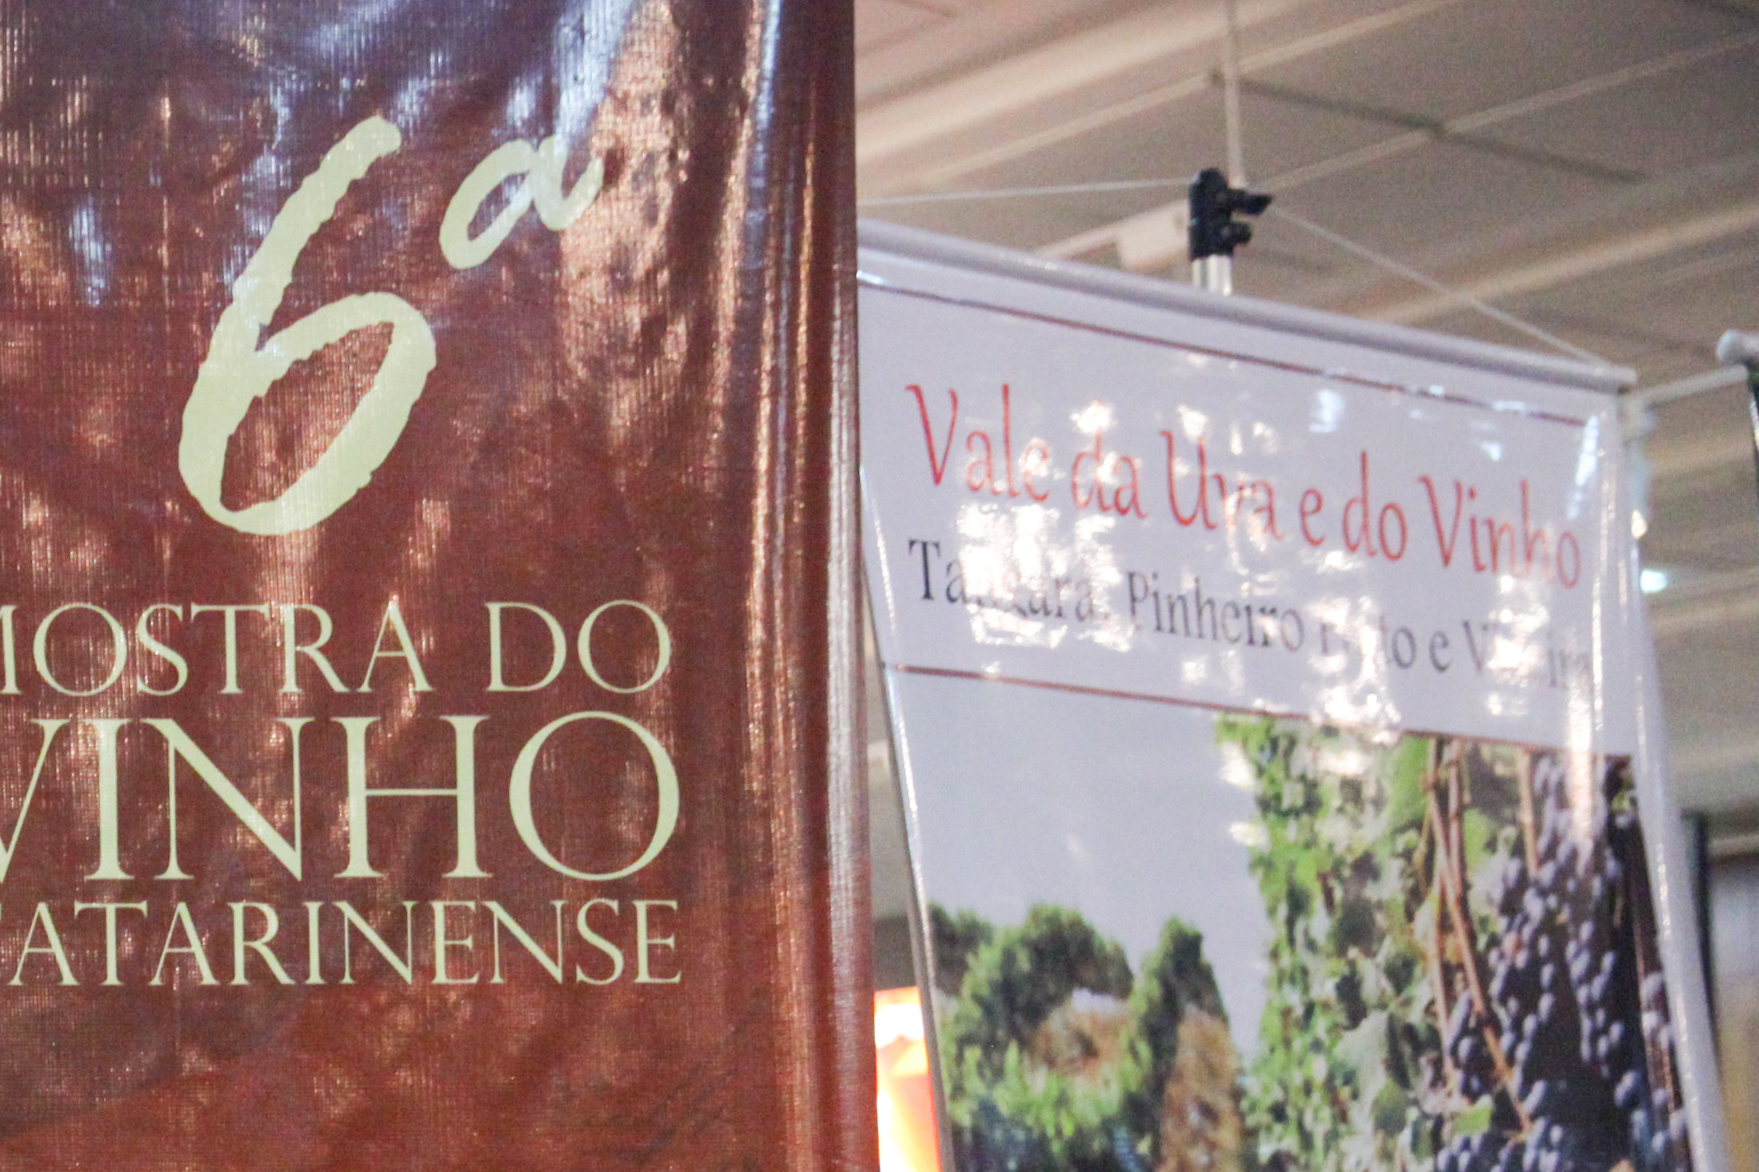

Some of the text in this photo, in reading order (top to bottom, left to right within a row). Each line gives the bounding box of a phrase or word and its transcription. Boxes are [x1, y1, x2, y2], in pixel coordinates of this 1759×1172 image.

[905, 384, 1581, 589] Vale da Uva e do Vinho
[486, 600, 672, 693] DO
[1128, 571, 1304, 651] Pinheiro
[1429, 630, 1452, 673] e
